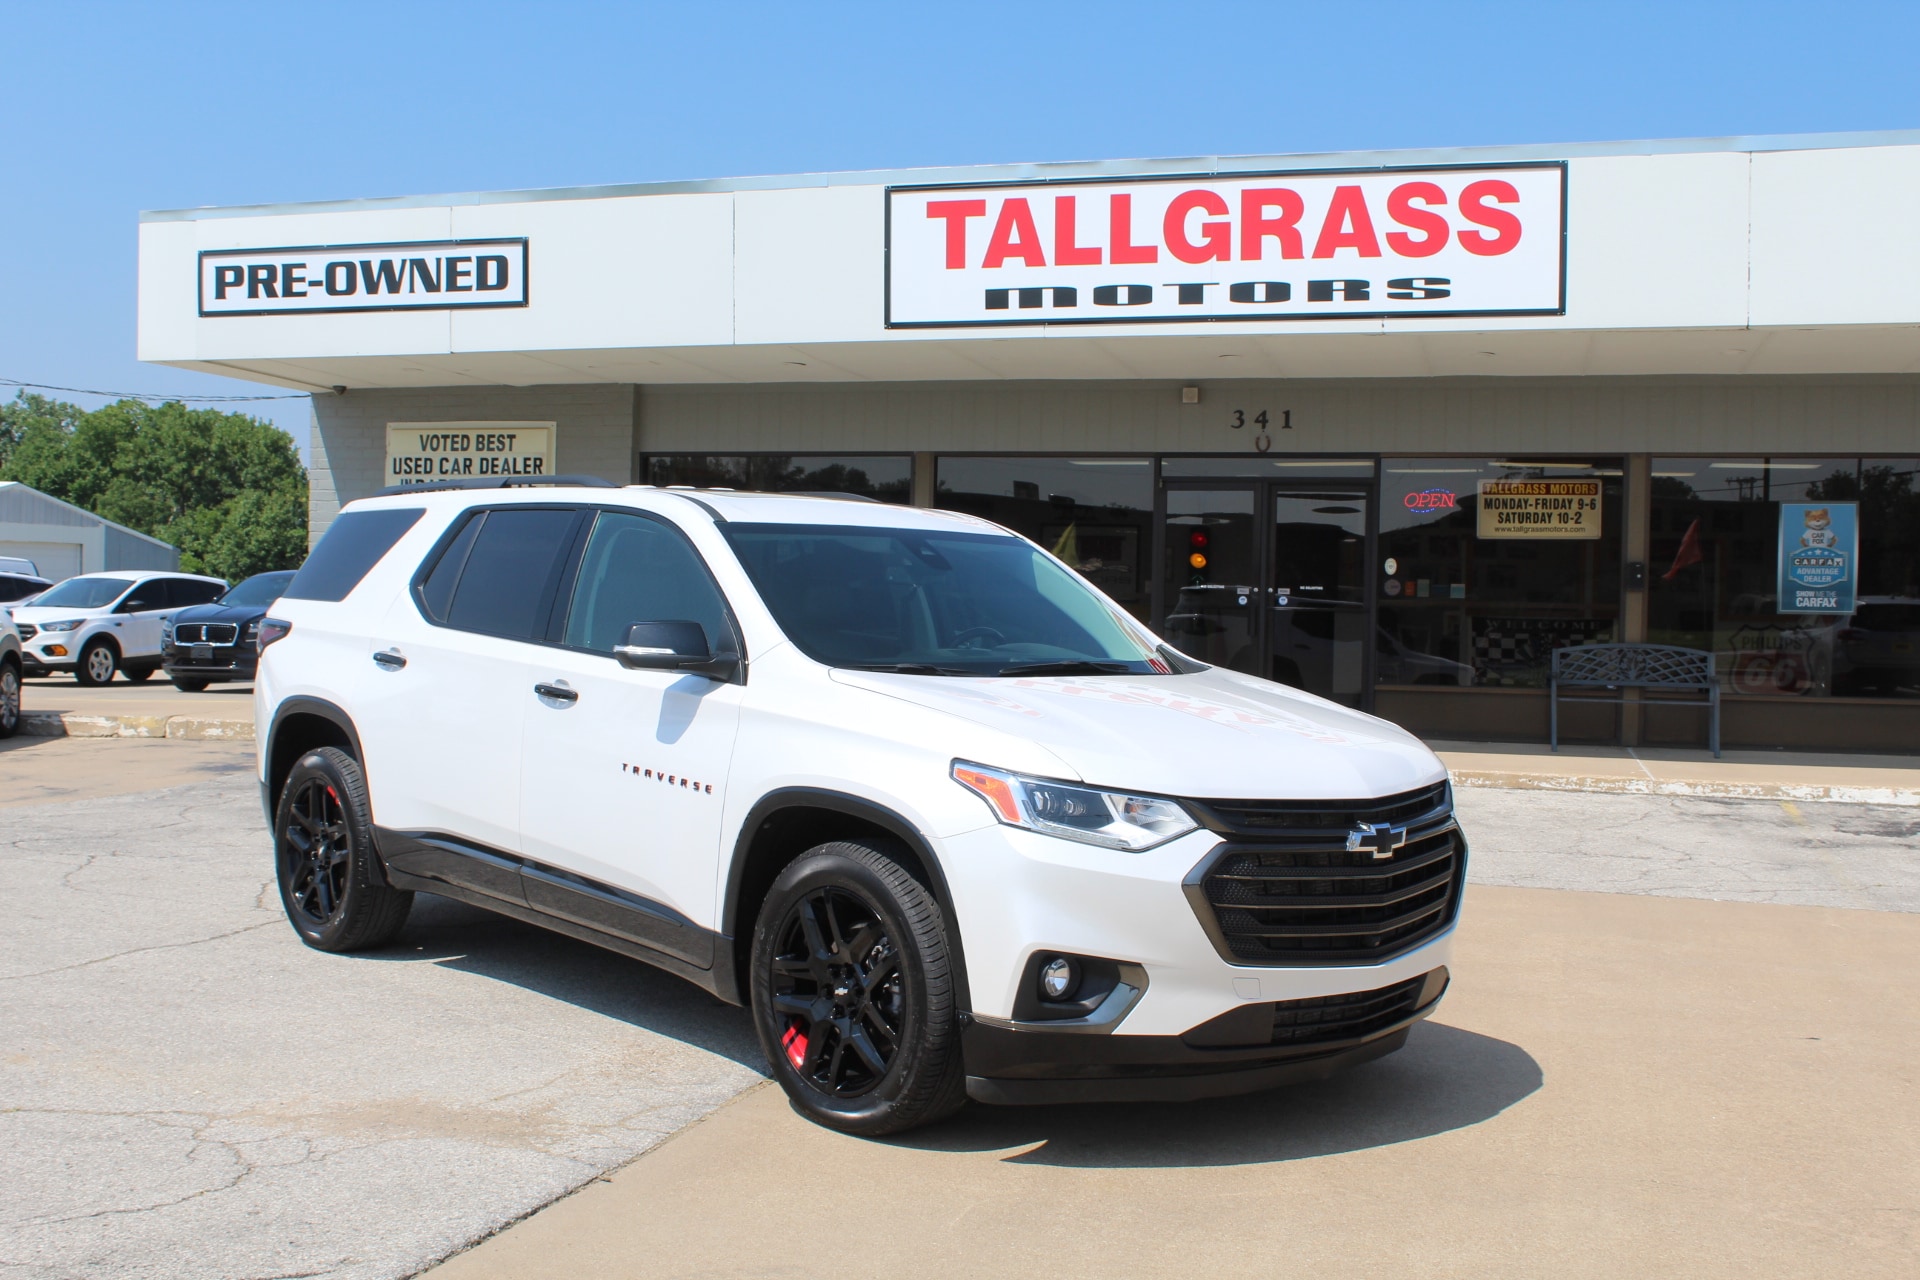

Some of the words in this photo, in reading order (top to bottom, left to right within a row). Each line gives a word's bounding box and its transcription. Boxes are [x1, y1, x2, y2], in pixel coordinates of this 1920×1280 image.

[926, 179, 1523, 269] TALLGRASS
[214, 254, 509, 300] PRE-OWNED
[1230, 409, 1293, 430] 341
[419, 434, 470, 452] VOTED
[475, 434, 516, 452] BEST
[393, 457, 433, 475] USED
[439, 457, 473, 475] CAR
[479, 457, 543, 475] DEALER
[1485, 484, 1546, 495] TALLGRASS
[1550, 483, 1596, 495] MOTORS
[1404, 492, 1456, 508] OPEN
[1484, 498, 1573, 510] MONDAY-FRIDAY
[1577, 498, 1597, 510] 9-6
[1497, 512, 1553, 525] SATURDAY
[1557, 511, 1582, 525] 10-2
[1494, 525, 1586, 534] www.tallgrassmotors.com
[1794, 558, 1843, 567] CARFAX
[1796, 567, 1840, 575] ADVANTAGE
[1803, 575, 1832, 583] DEALER
[1796, 590, 1815, 598] SHOW
[1796, 597, 1838, 608] CARFAX
[1485, 619, 1601, 630] WELCOME
[1742, 635, 1802, 650] PHILLIPS
[1744, 656, 1797, 687] 66
[622, 762, 713, 795] TRAVERSE
